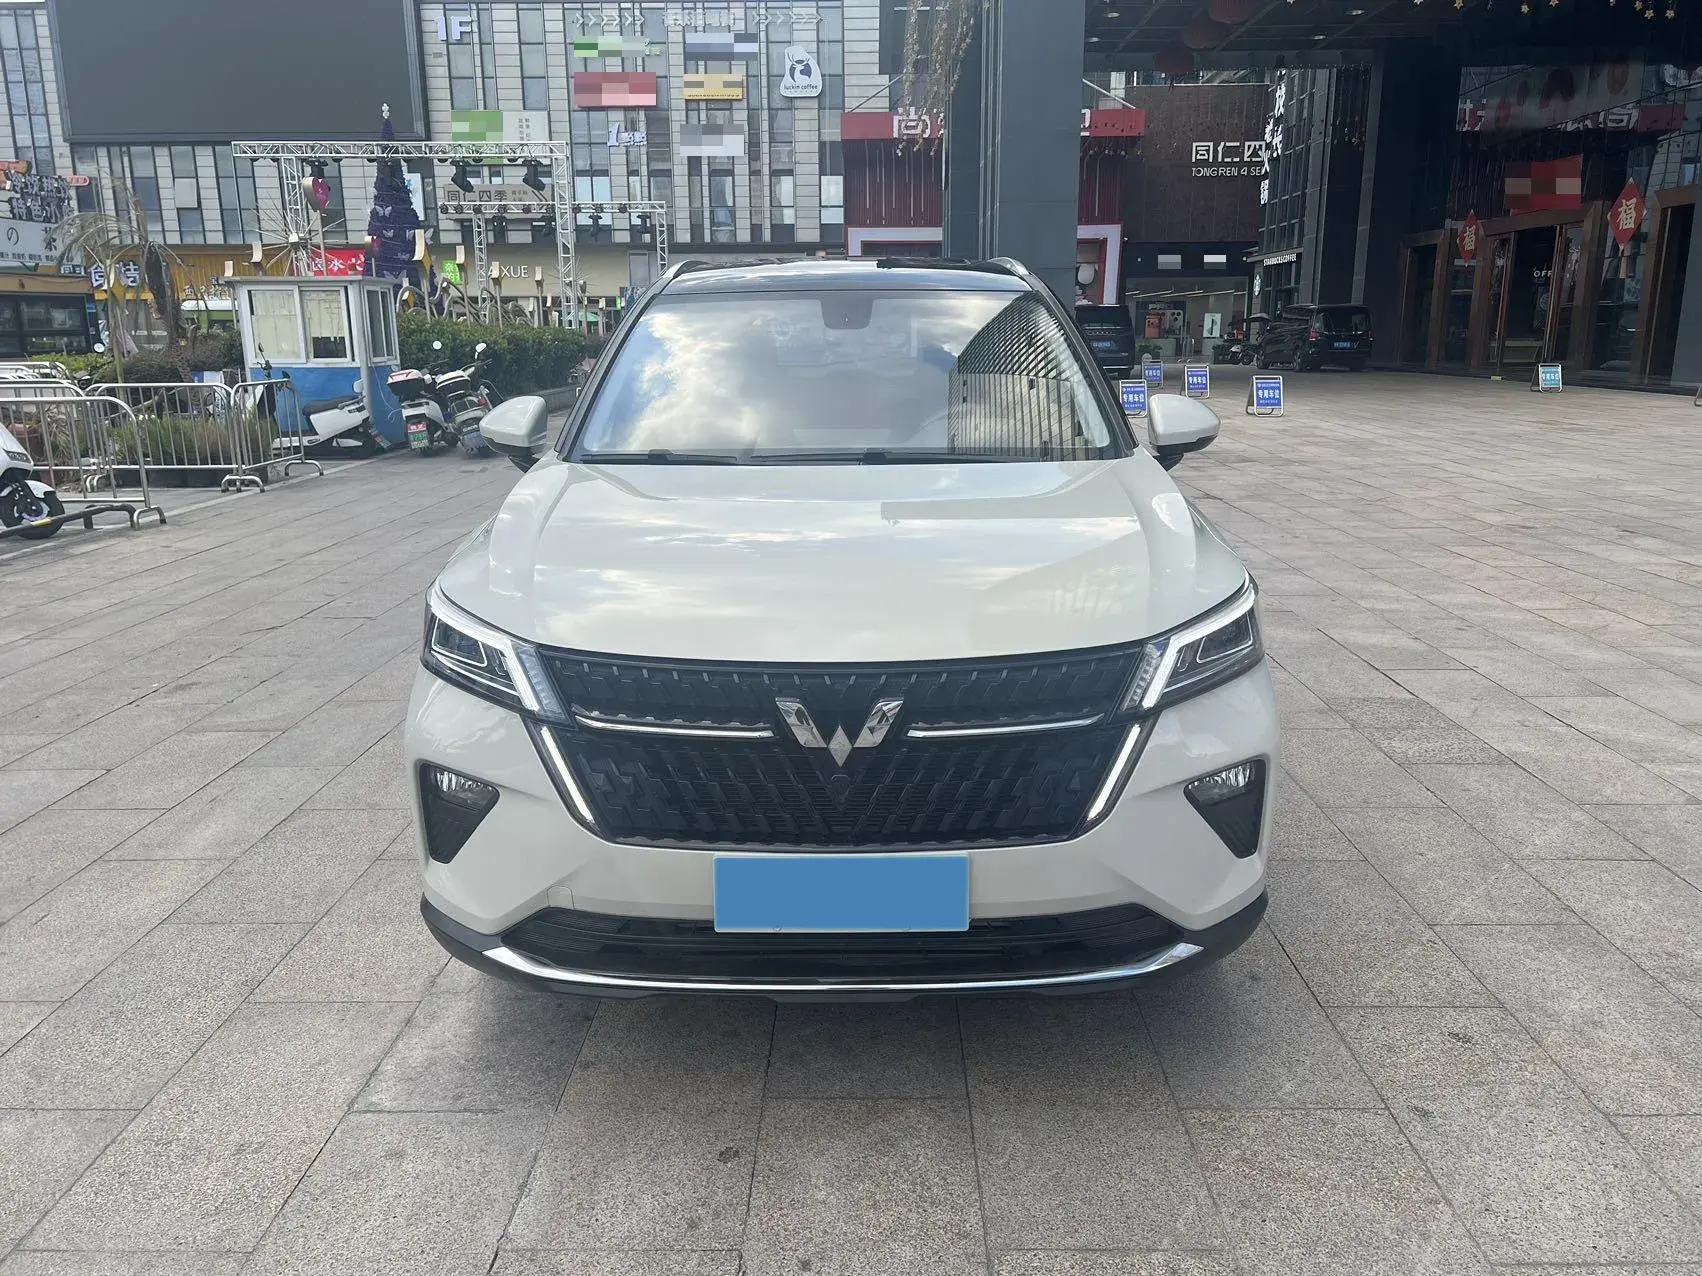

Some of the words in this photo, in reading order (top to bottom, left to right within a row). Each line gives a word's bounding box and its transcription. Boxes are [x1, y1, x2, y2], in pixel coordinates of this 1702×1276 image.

[437, 15, 472, 41] 1F
[1191, 141, 1266, 163] 同仁四
[1191, 167, 1238, 177] TONGREN
[1240, 167, 1248, 176] 4
[1616, 197, 1637, 230] 福
[1463, 225, 1476, 251] 福
[1122, 393, 1145, 403] 专用车位
[1257, 389, 1280, 398] 专用车位
